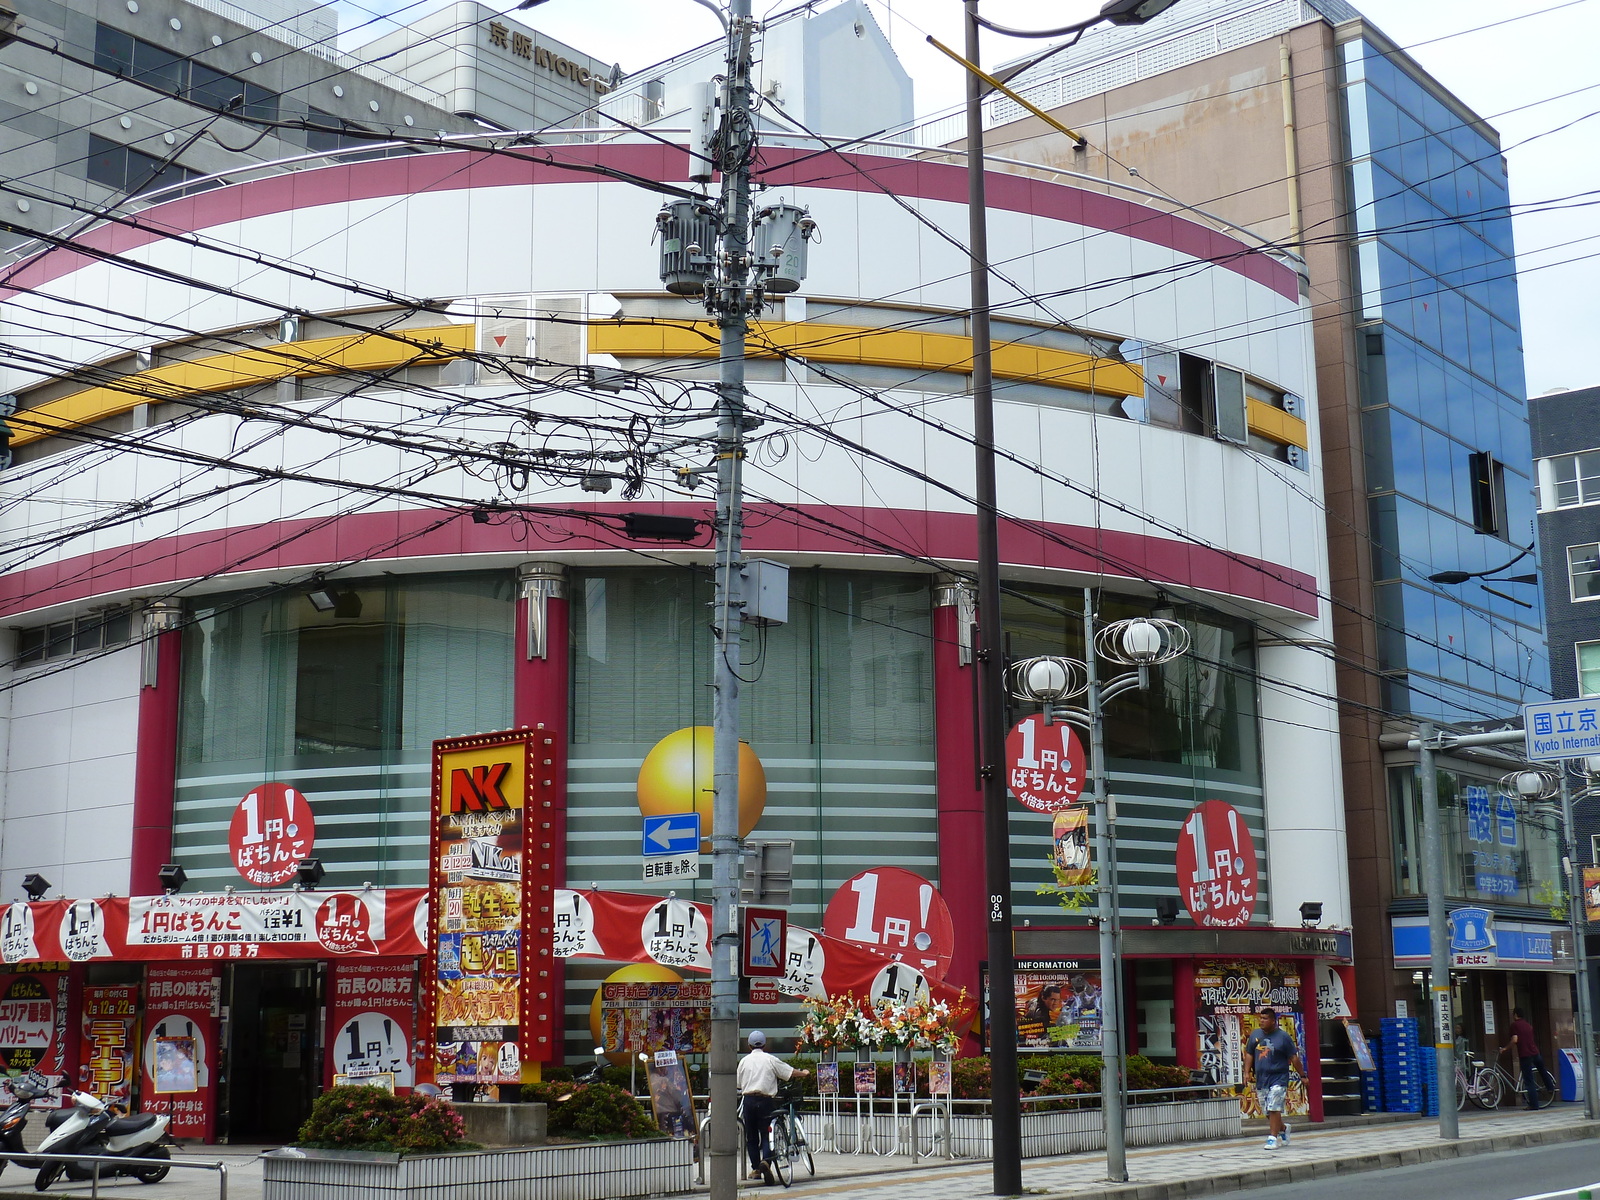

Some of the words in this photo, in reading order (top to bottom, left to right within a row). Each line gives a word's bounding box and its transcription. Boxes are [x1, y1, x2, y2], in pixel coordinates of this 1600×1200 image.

[489, 20, 533, 61] 京阪
[535, 45, 592, 87] KYOTO
[1533, 707, 1599, 736] 国立京
[1017, 718, 1072, 773] 1円!
[1533, 736, 1560, 755] Kyoto
[451, 762, 512, 815] NK
[1011, 768, 1077, 795] ぱちんこ
[1019, 790, 1070, 812] 4倍あそべる
[241, 788, 299, 845] 1円!
[238, 840, 306, 868] ぱちんこ
[1186, 809, 1245, 884] 1円!
[246, 861, 298, 884] 4倍あそべる
[453, 857, 461, 869] 12
[462, 856, 471, 868] 22
[645, 860, 697, 878] 自転車を除く
[1189, 877, 1253, 912] ぱちんこ
[1479, 876, 1516, 894] 中学生クラス
[449, 901, 460, 916] 20
[990, 894, 1003, 904] 00
[993, 902, 1000, 911] 8
[68, 902, 97, 937] 1円!
[324, 898, 361, 927] 1円!
[553, 895, 583, 928] 円!
[654, 903, 697, 938] 1円!
[845, 872, 935, 951] 1円!
[991, 910, 1003, 919] 04
[141, 911, 242, 934] 1円ぱちんこ
[264, 917, 281, 929] 1玉
[319, 927, 366, 942] ぱちんこ
[181, 944, 260, 959] 市民の味方
[324, 940, 358, 954] 4倍あそべる
[650, 938, 699, 955] ぱちんこ
[786, 938, 816, 972] 円!
[653, 951, 696, 966] 4倍あそべる
[1018, 961, 1079, 969] INFORMATION
[11, 983, 41, 997] ぱちんこ
[149, 980, 211, 997] 市民の味方
[337, 977, 412, 994] 市民の味方
[752, 991, 776, 1001] わたるな
[1, 1002, 51, 1022] エリア最強
[1440, 993, 1451, 1041] 国土交通省
[54, 976, 68, 1072] 好感度アップ
[0, 1025, 49, 1044] バリューへ
[346, 1019, 393, 1060] 1円!
[144, 1099, 203, 1111] サイフの中身は
